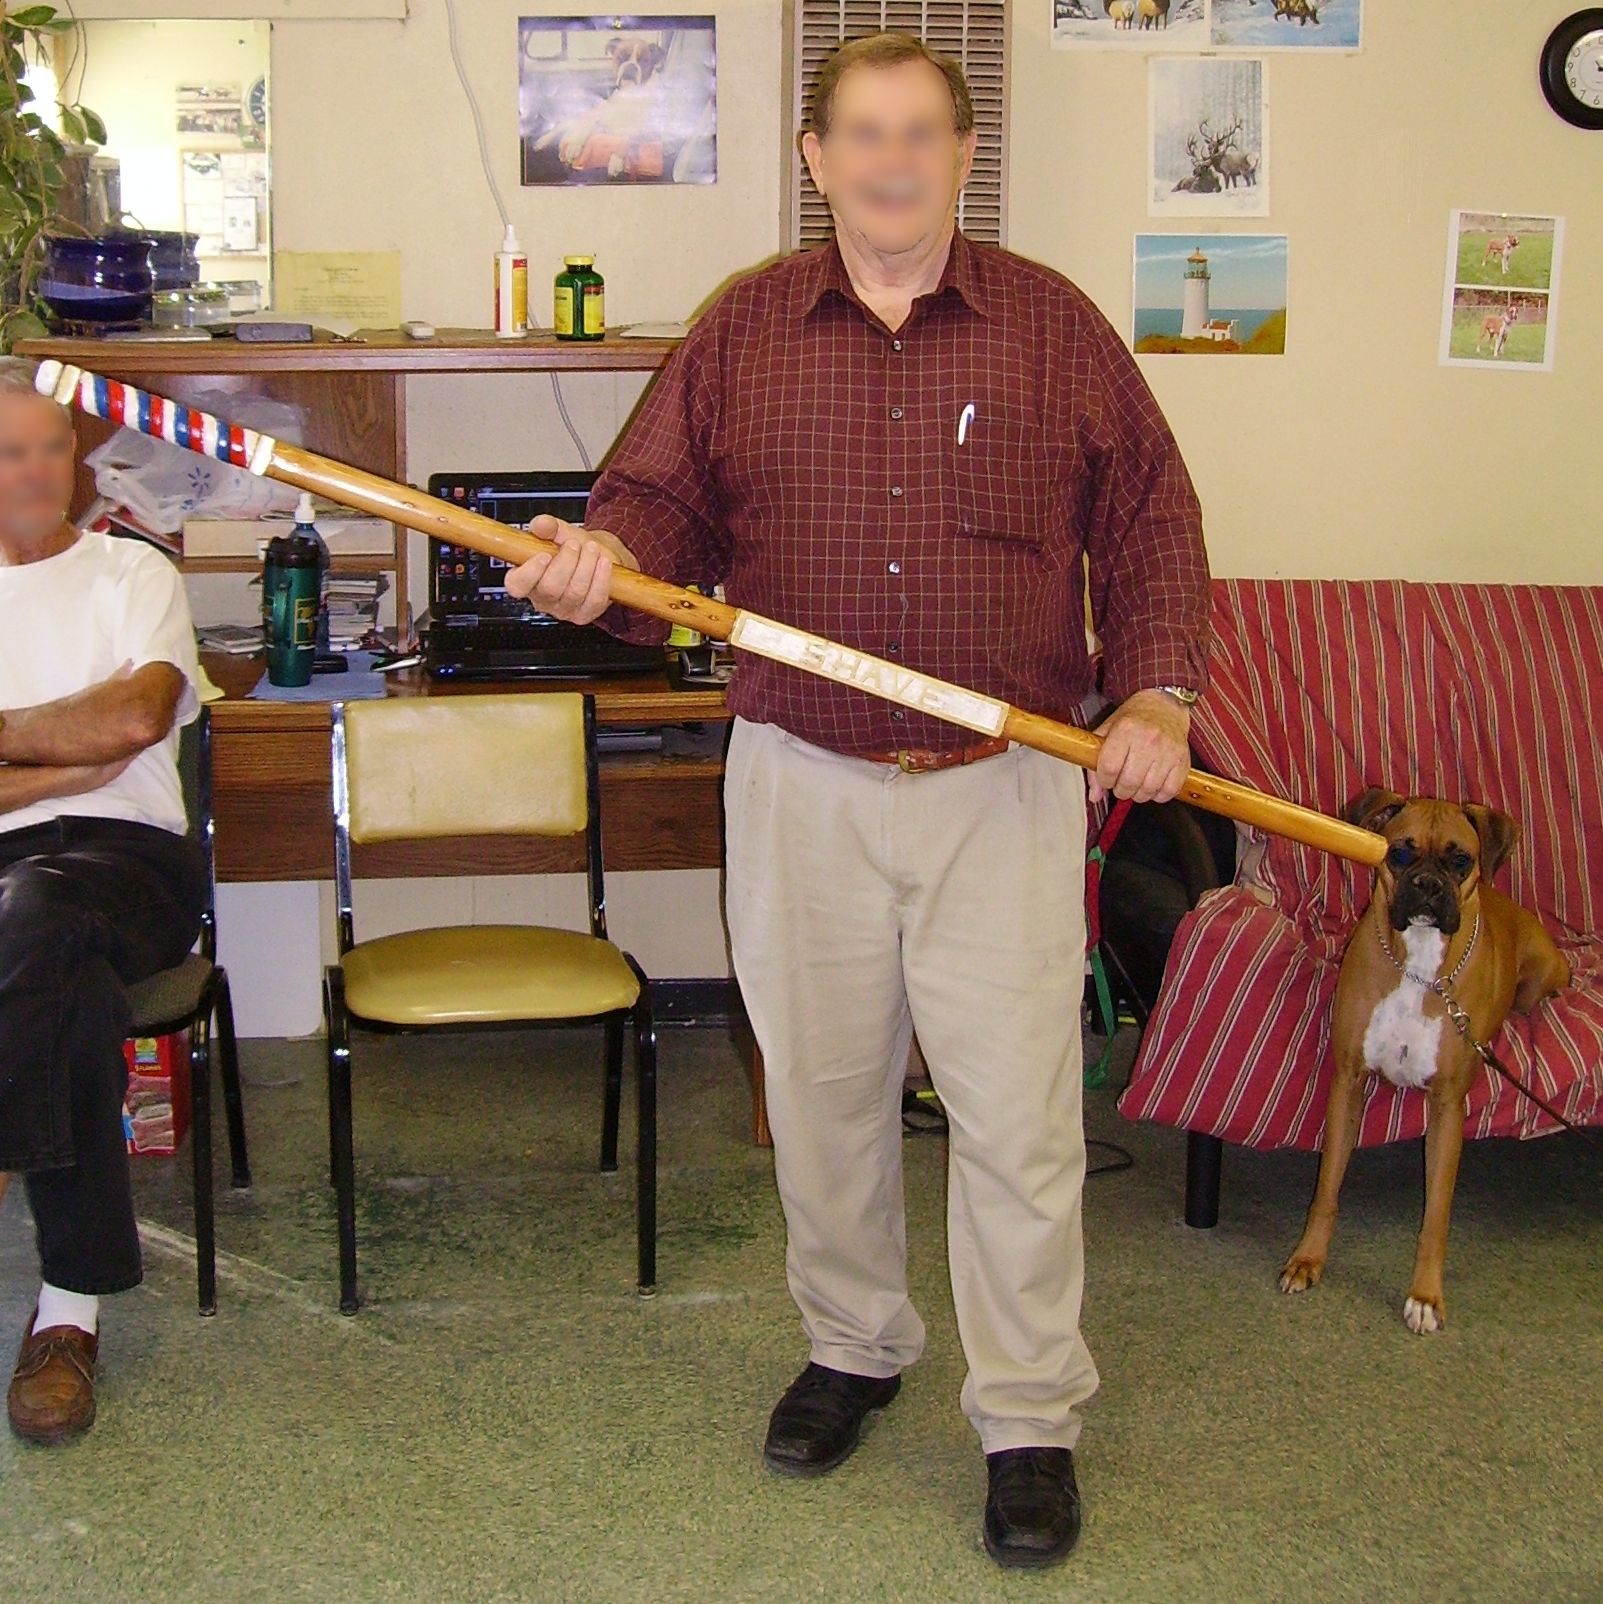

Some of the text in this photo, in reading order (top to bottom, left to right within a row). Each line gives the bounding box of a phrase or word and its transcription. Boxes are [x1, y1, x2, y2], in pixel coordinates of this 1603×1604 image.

[1570, 77, 1577, 88] 8
[1593, 95, 1600, 106] 6
[801, 642, 943, 709] SHAVE
